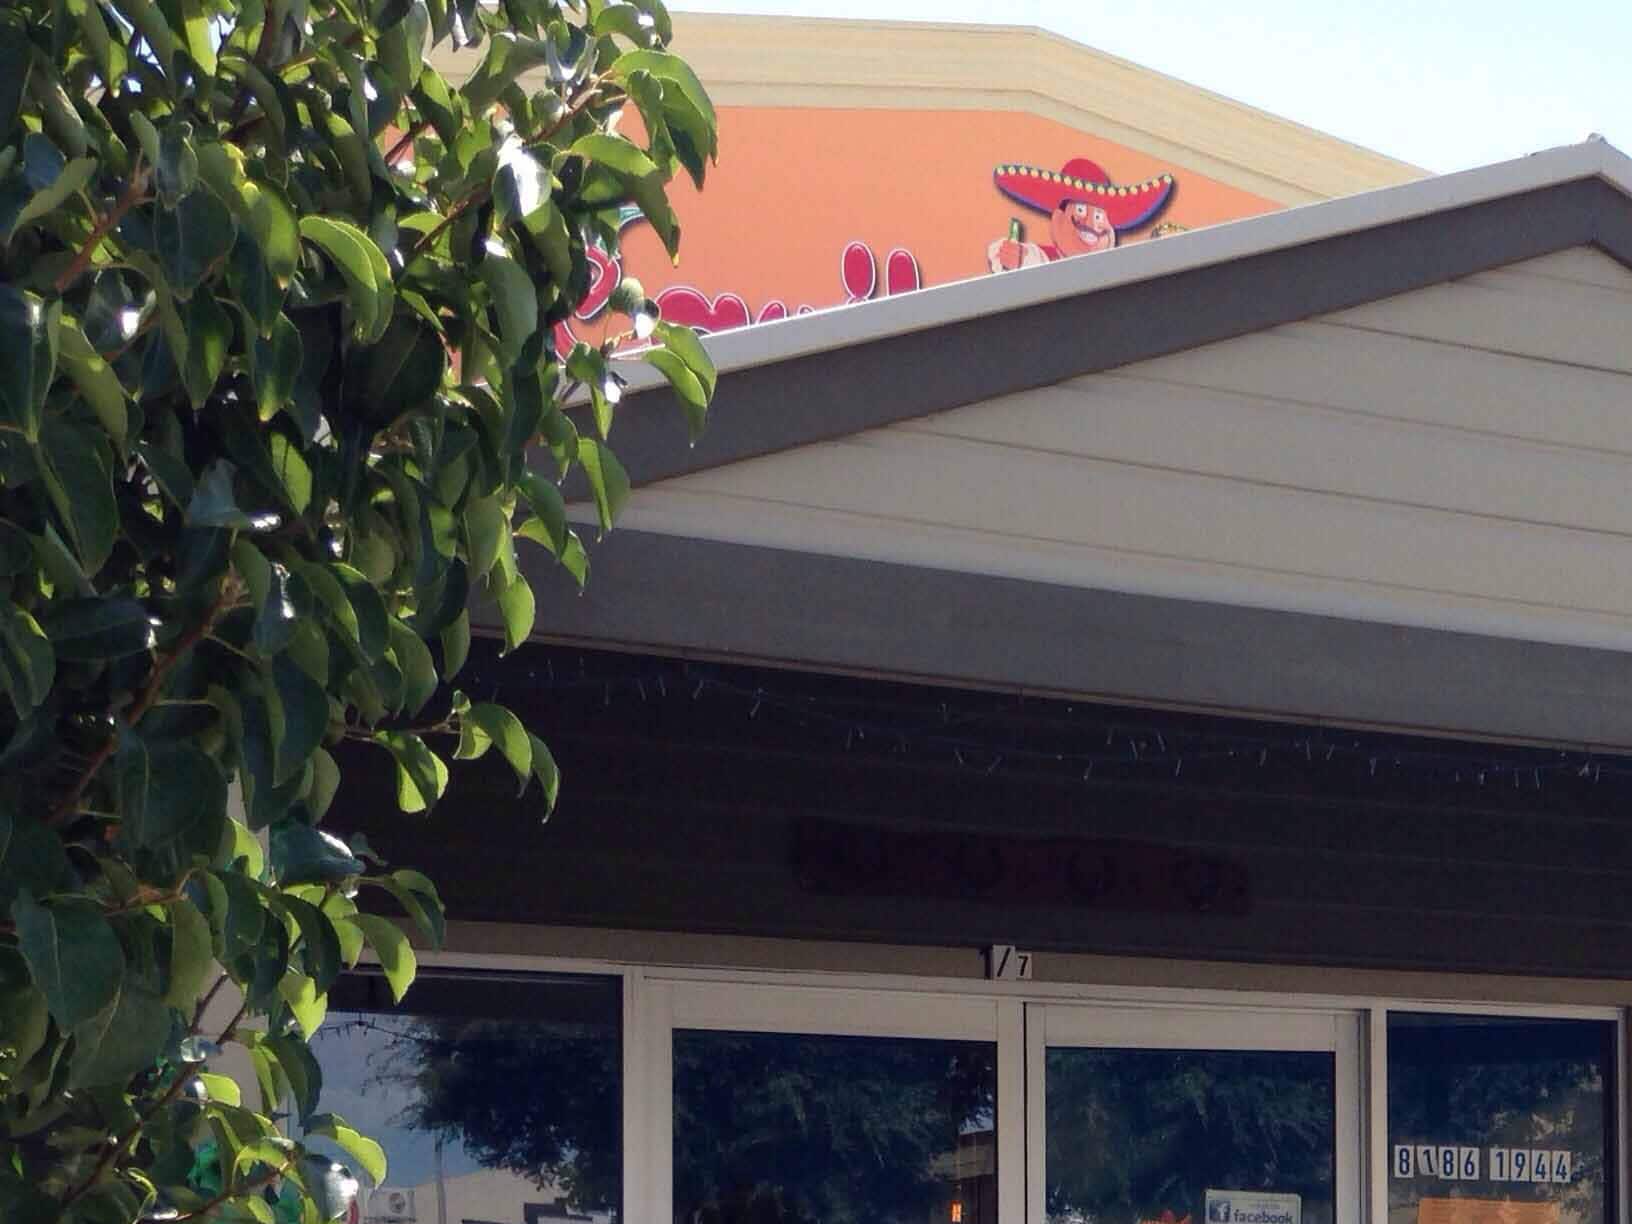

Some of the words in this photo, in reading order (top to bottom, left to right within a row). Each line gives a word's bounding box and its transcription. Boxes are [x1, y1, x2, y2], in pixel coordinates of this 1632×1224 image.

[1399, 1148, 1477, 1178] 8186
[1495, 1150, 1568, 1181] 1944
[1233, 1208, 1294, 1224] facebook
